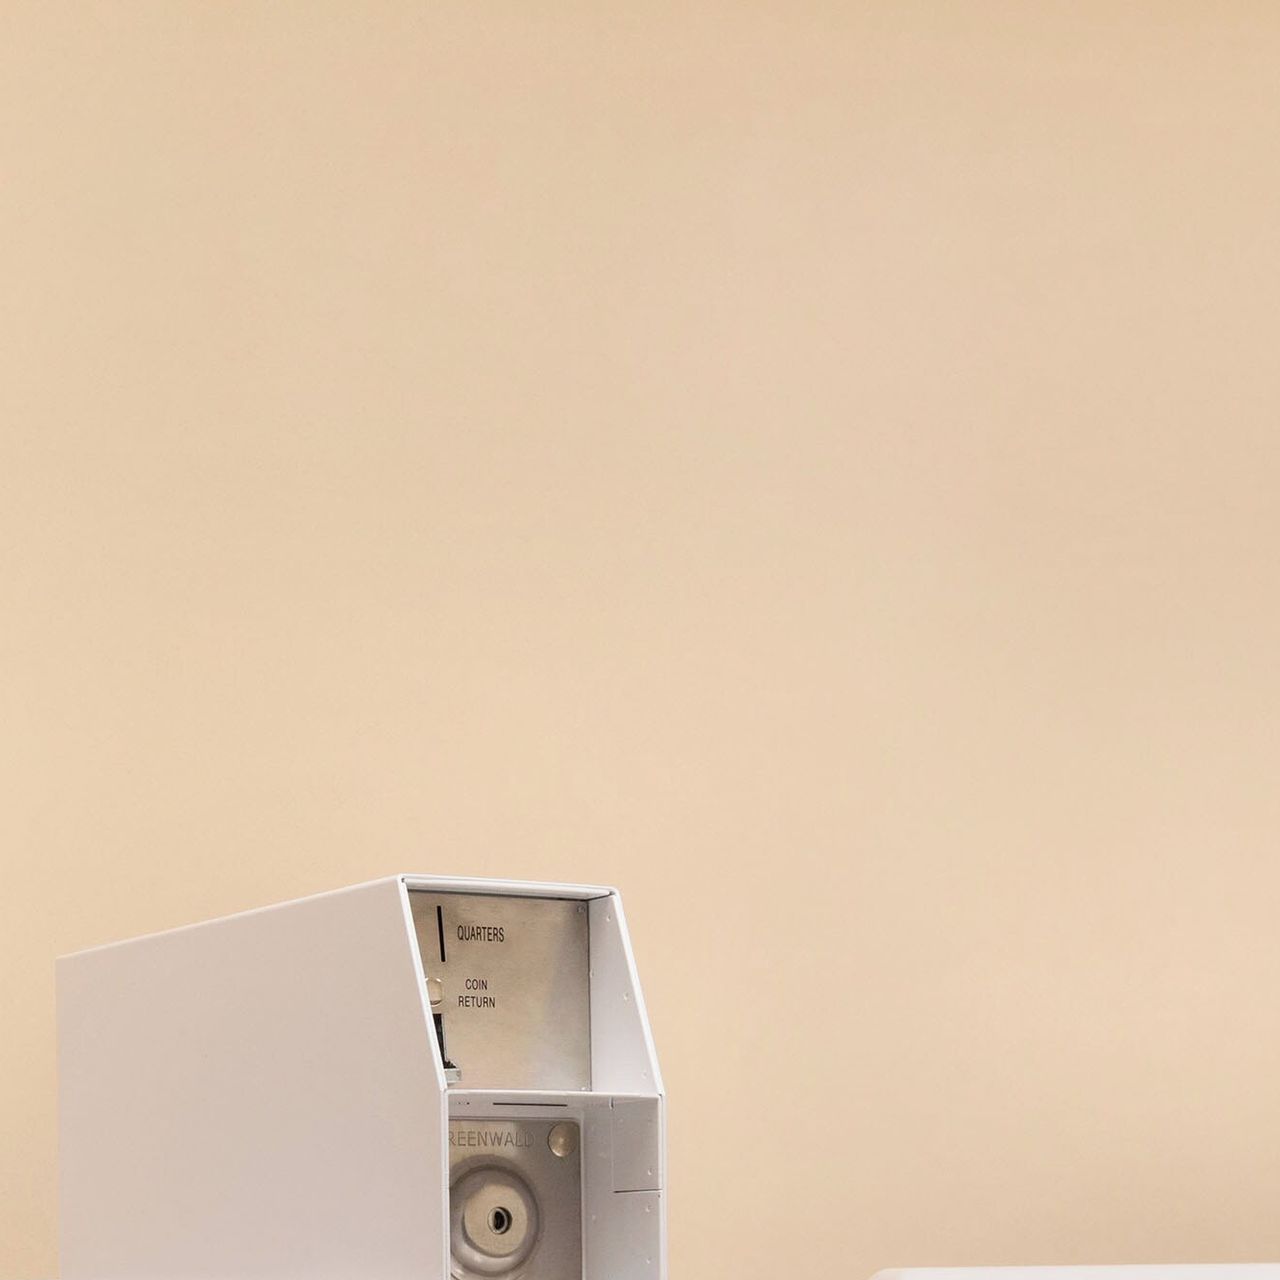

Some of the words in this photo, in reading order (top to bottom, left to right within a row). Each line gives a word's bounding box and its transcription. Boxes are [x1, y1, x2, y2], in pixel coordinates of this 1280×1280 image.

[457, 925, 504, 942] QUARTERS
[466, 978, 488, 990] COIN
[458, 996, 496, 1008] RETURN
[448, 1130, 535, 1147] REENWALD
